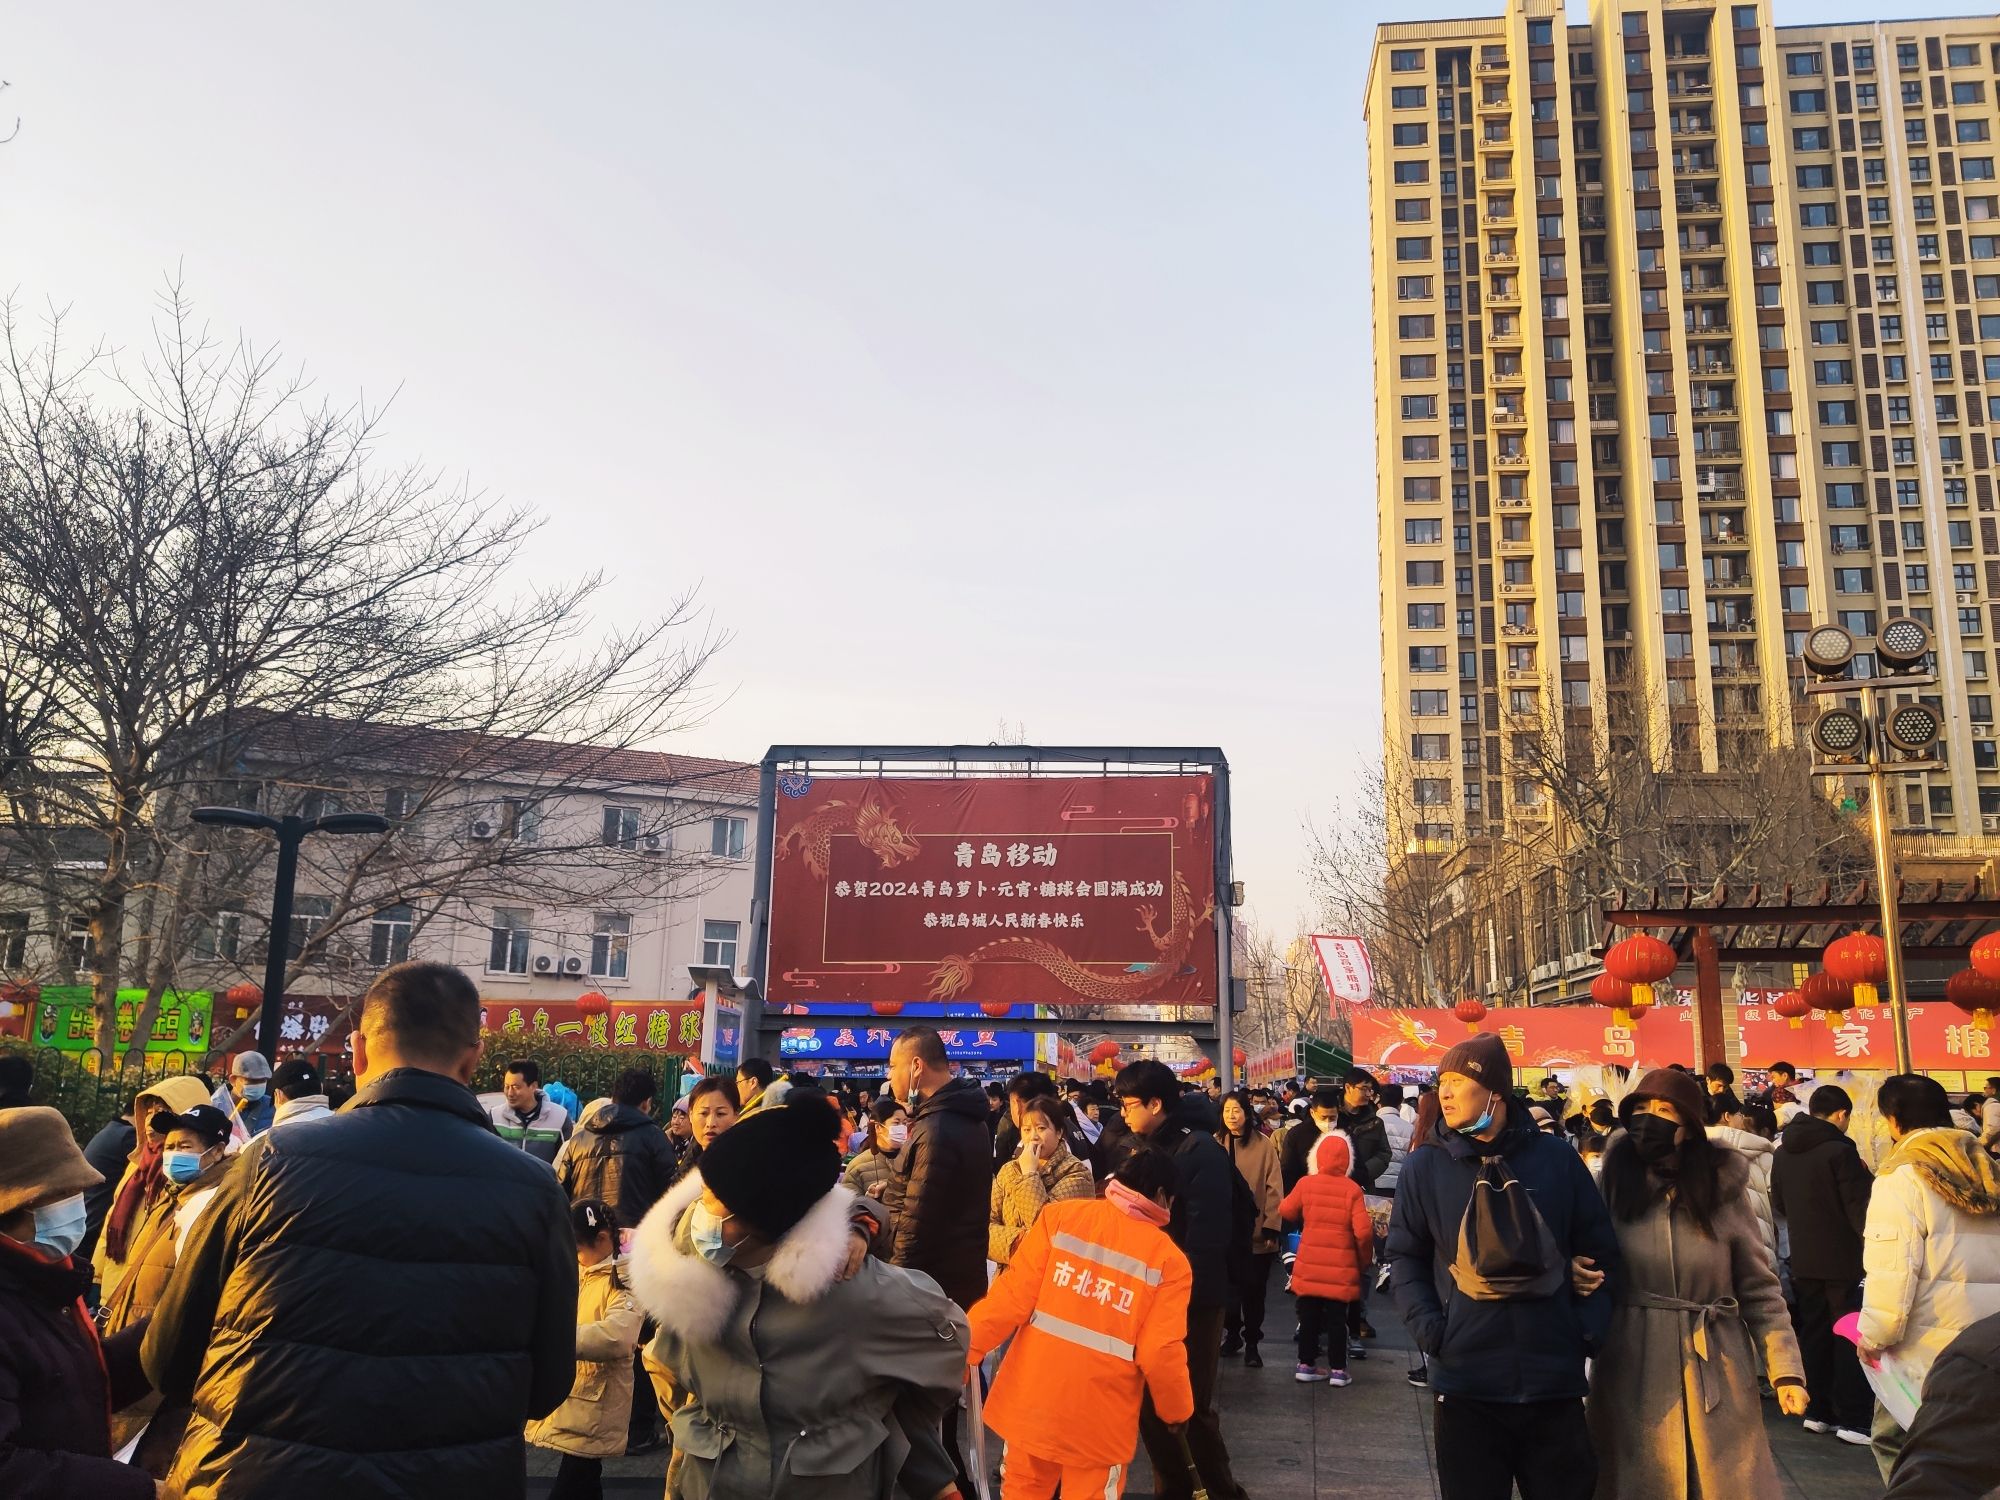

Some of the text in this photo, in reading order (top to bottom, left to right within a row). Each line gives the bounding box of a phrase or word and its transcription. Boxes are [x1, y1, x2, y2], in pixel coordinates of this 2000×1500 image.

[953, 842, 1058, 868] 青岛移动
[834, 880, 1164, 898] 恭贺2024青岛萝卜·元宵·糖球会圆满成功
[923, 912, 1085, 928] 恭祝岛城人民新春快乐
[1052, 1260, 1134, 1315] 市北环卫
